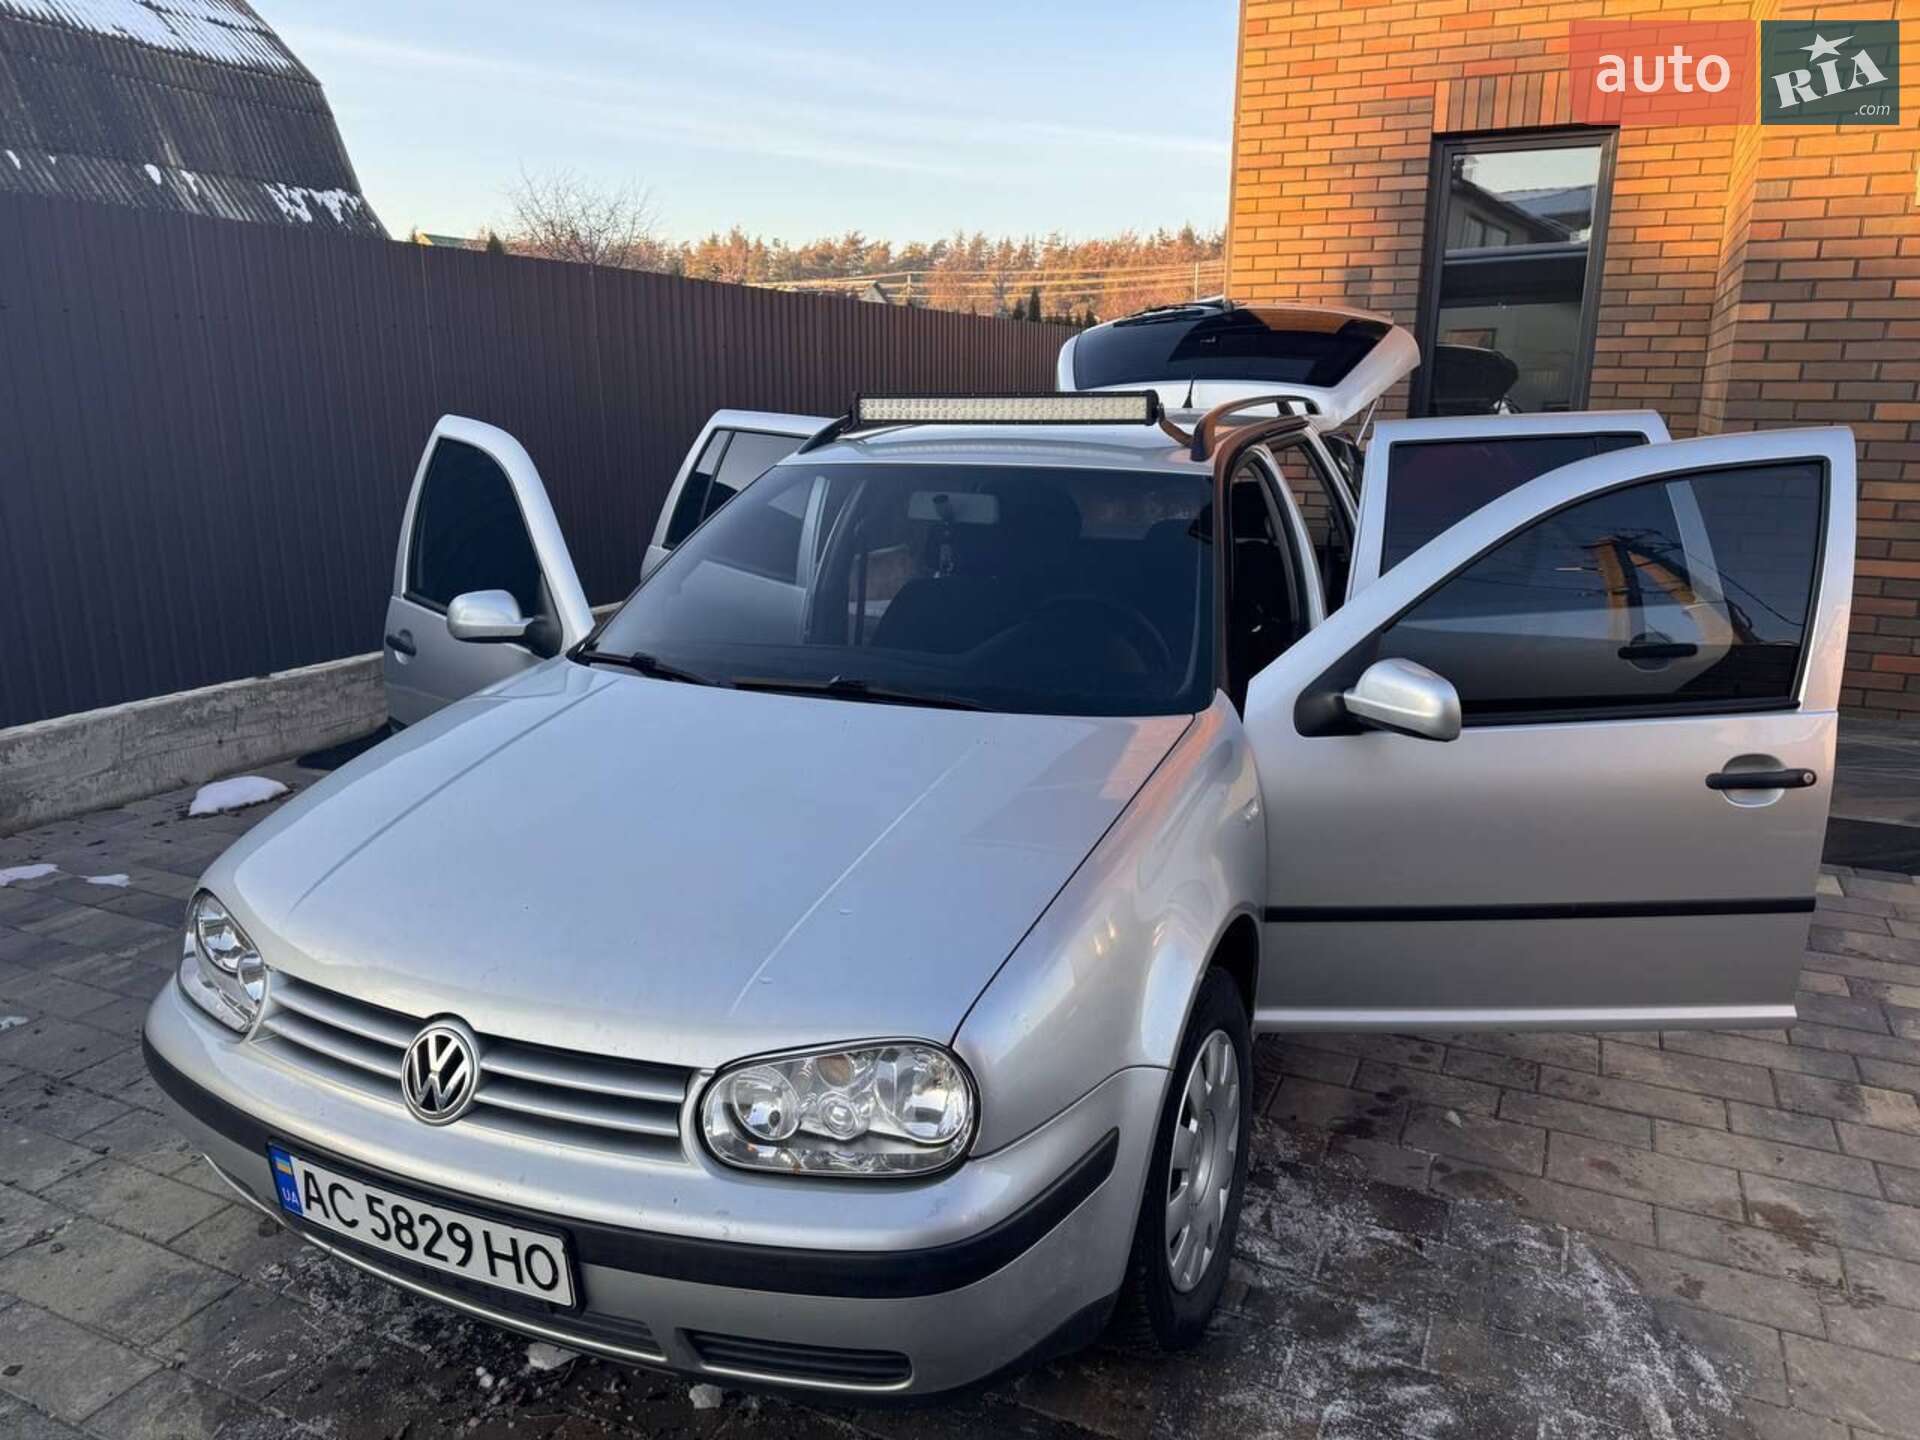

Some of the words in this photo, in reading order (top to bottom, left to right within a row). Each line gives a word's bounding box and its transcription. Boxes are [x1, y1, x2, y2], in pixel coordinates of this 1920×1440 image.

[282, 1187, 299, 1207] UA
[303, 1169, 359, 1229] AC
[365, 1193, 473, 1268] 5829
[483, 1230, 559, 1292] HO
